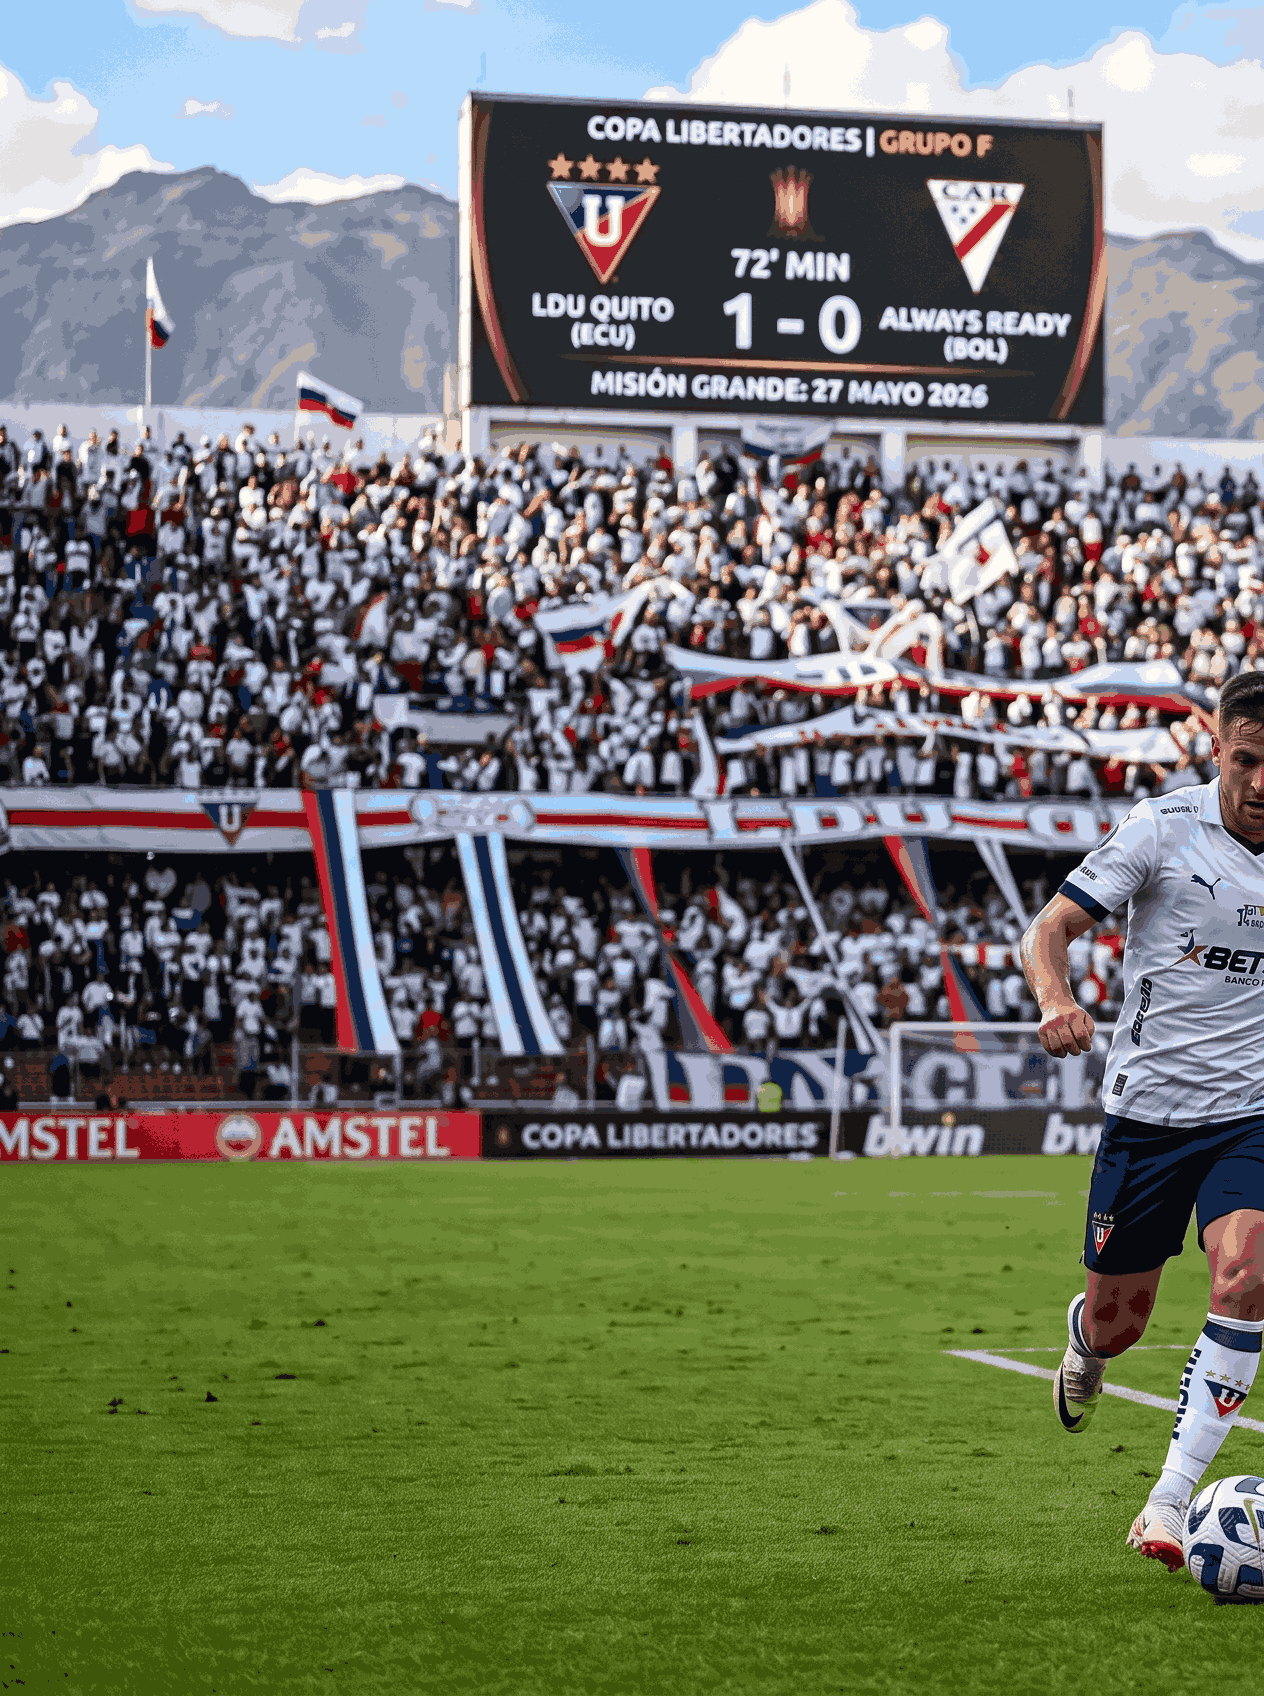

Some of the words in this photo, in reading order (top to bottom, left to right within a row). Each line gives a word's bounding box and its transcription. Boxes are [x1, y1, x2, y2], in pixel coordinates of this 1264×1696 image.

[587, 115, 663, 143] COPA
[665, 118, 863, 153] LIBERTADORES
[879, 129, 972, 158] GRUPO
[976, 134, 994, 158] F
[582, 194, 625, 247] U
[730, 248, 779, 279] 72'
[785, 250, 851, 282] MIN
[531, 292, 586, 318] LDU
[589, 294, 675, 323] QUITO
[723, 292, 753, 350] 1
[818, 295, 862, 354] 0
[879, 306, 983, 334] ALWAYS
[986, 311, 1072, 338] READY
[571, 321, 636, 351] (ECU)
[943, 335, 1009, 364] (BOL)
[590, 367, 687, 398] MISIÓN
[691, 374, 808, 403] GRANDE:
[811, 378, 843, 403] 27
[848, 380, 925, 406] MAYO
[927, 382, 989, 408] 2026
[1224, 976, 1260, 987] BANCO
[269, 1116, 450, 1158] AMSTEL
[521, 1122, 601, 1149] COPA
[606, 1122, 820, 1149] LIBERTADORES
[863, 1111, 986, 1157] bwin
[1041, 1112, 1103, 1156] bw
